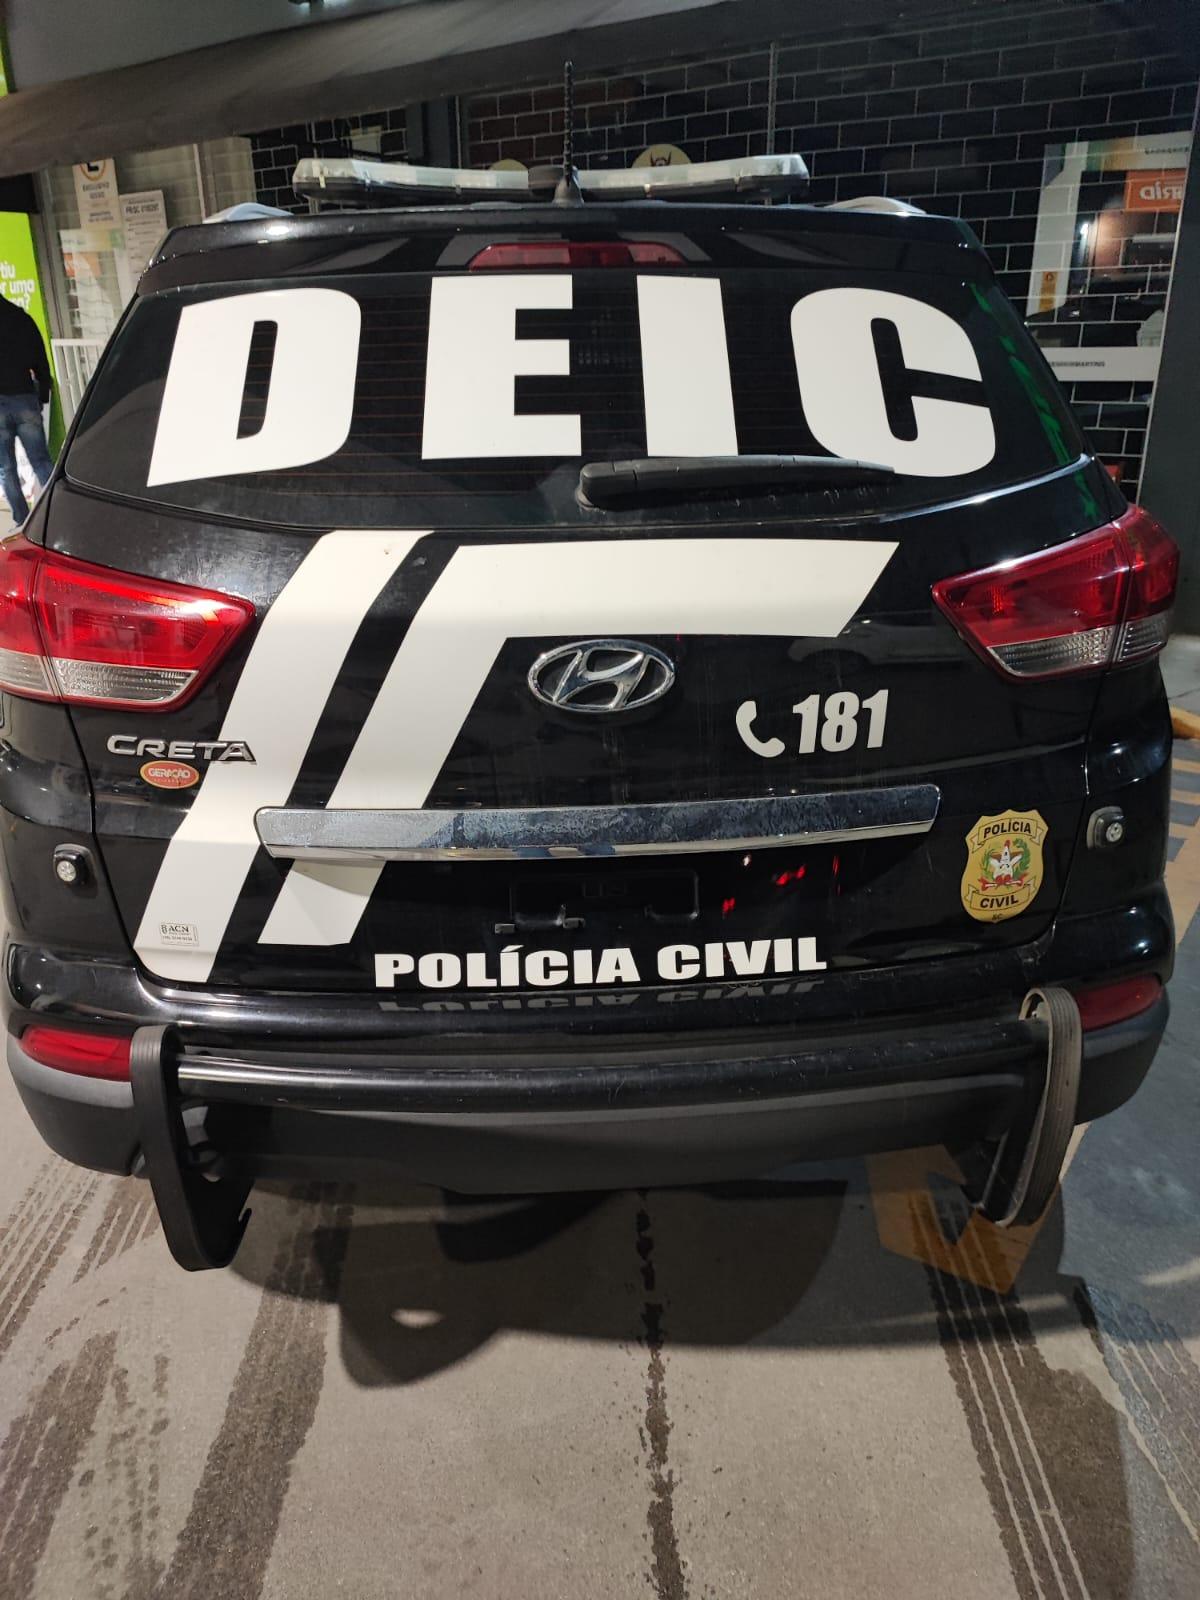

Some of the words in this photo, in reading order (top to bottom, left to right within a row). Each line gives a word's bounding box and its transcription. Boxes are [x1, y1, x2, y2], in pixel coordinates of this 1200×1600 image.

[10, 279, 35, 294] uma
[146, 273, 997, 488] DEIC
[792, 689, 889, 754] 181
[106, 734, 257, 762] CRETA
[983, 818, 1032, 839] POLÍCIA
[980, 894, 1019, 909] CIVIL
[374, 943, 641, 988] POLÍCIA
[657, 936, 828, 981] CIVIL
